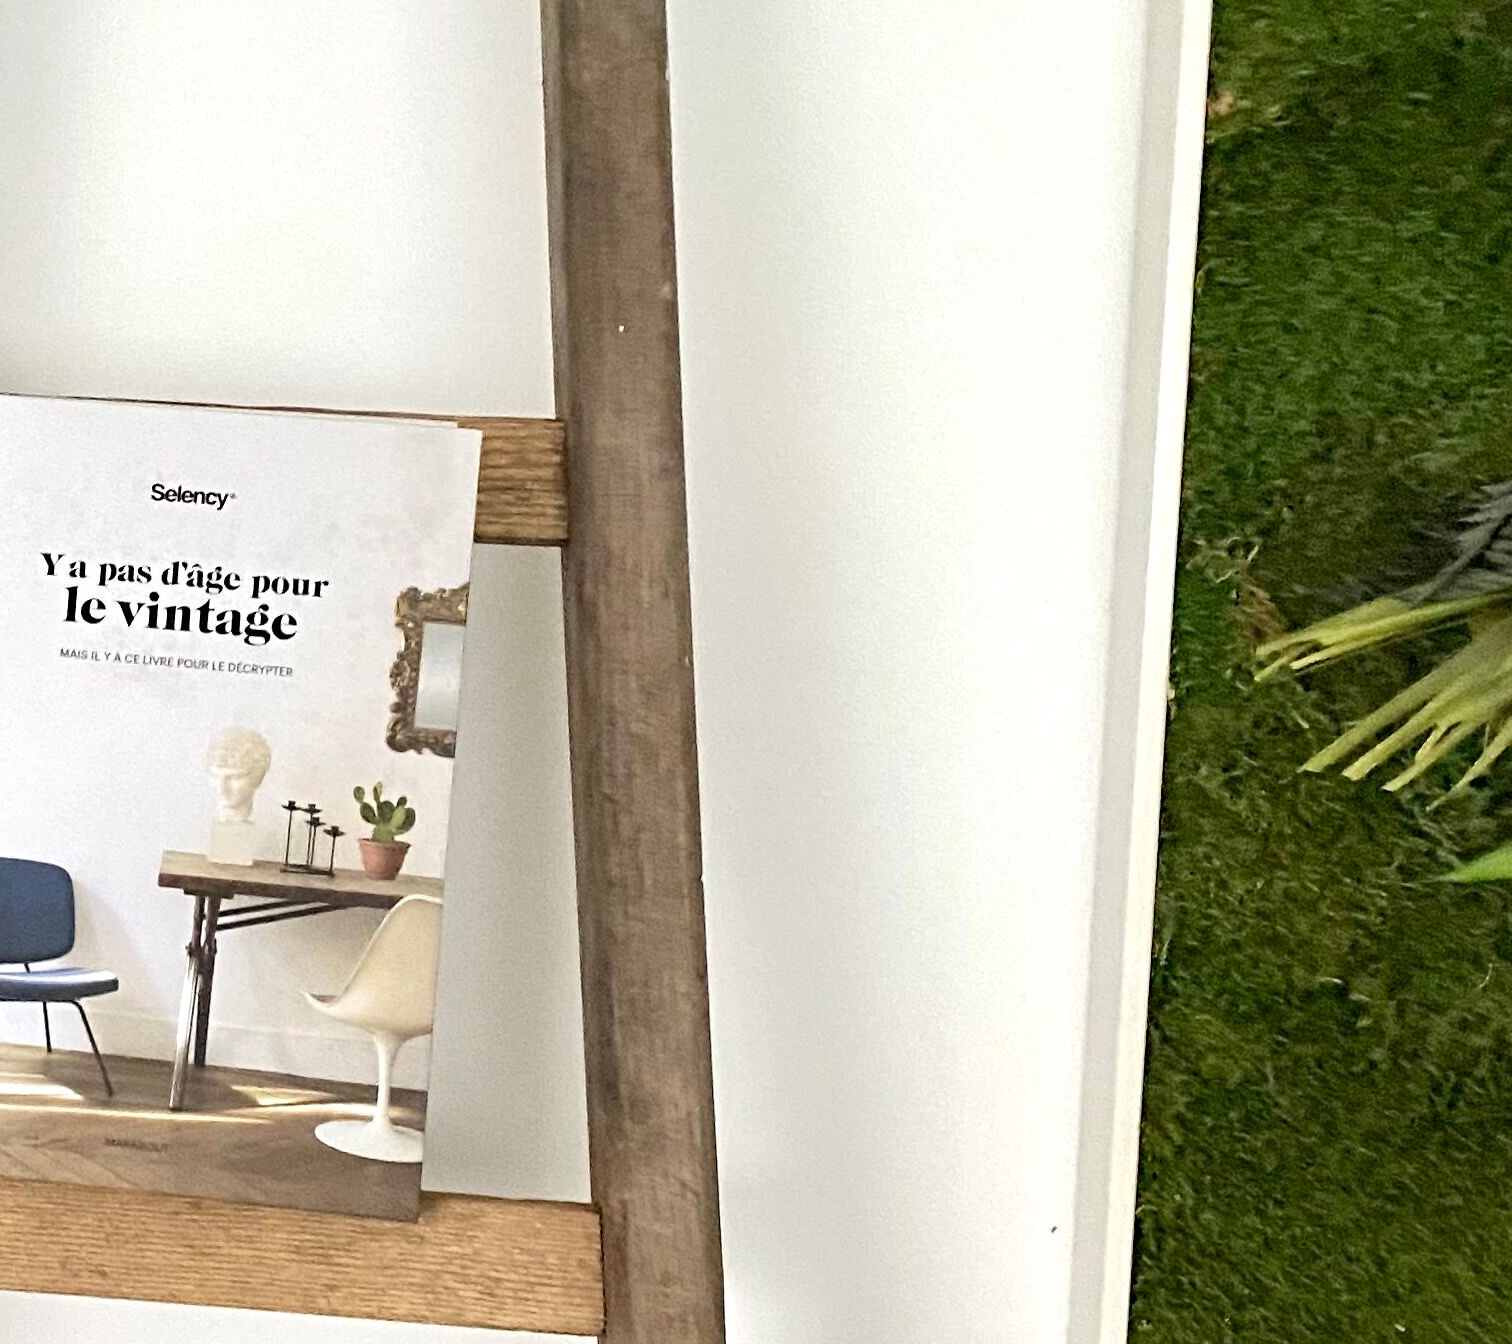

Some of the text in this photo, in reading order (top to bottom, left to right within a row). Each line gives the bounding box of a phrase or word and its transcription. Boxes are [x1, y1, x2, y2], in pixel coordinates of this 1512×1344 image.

[98, 562, 152, 587] pas
[161, 560, 241, 595] d'âge
[251, 574, 329, 599] pour
[62, 585, 298, 647] le vintage
[60, 648, 87, 660] MAIS
[91, 651, 101, 662] IL
[103, 651, 111, 662] Y
[125, 654, 140, 665] CE
[143, 655, 174, 667] LIVRE
[177, 658, 209, 670] POUR
[212, 661, 225, 672] LE
